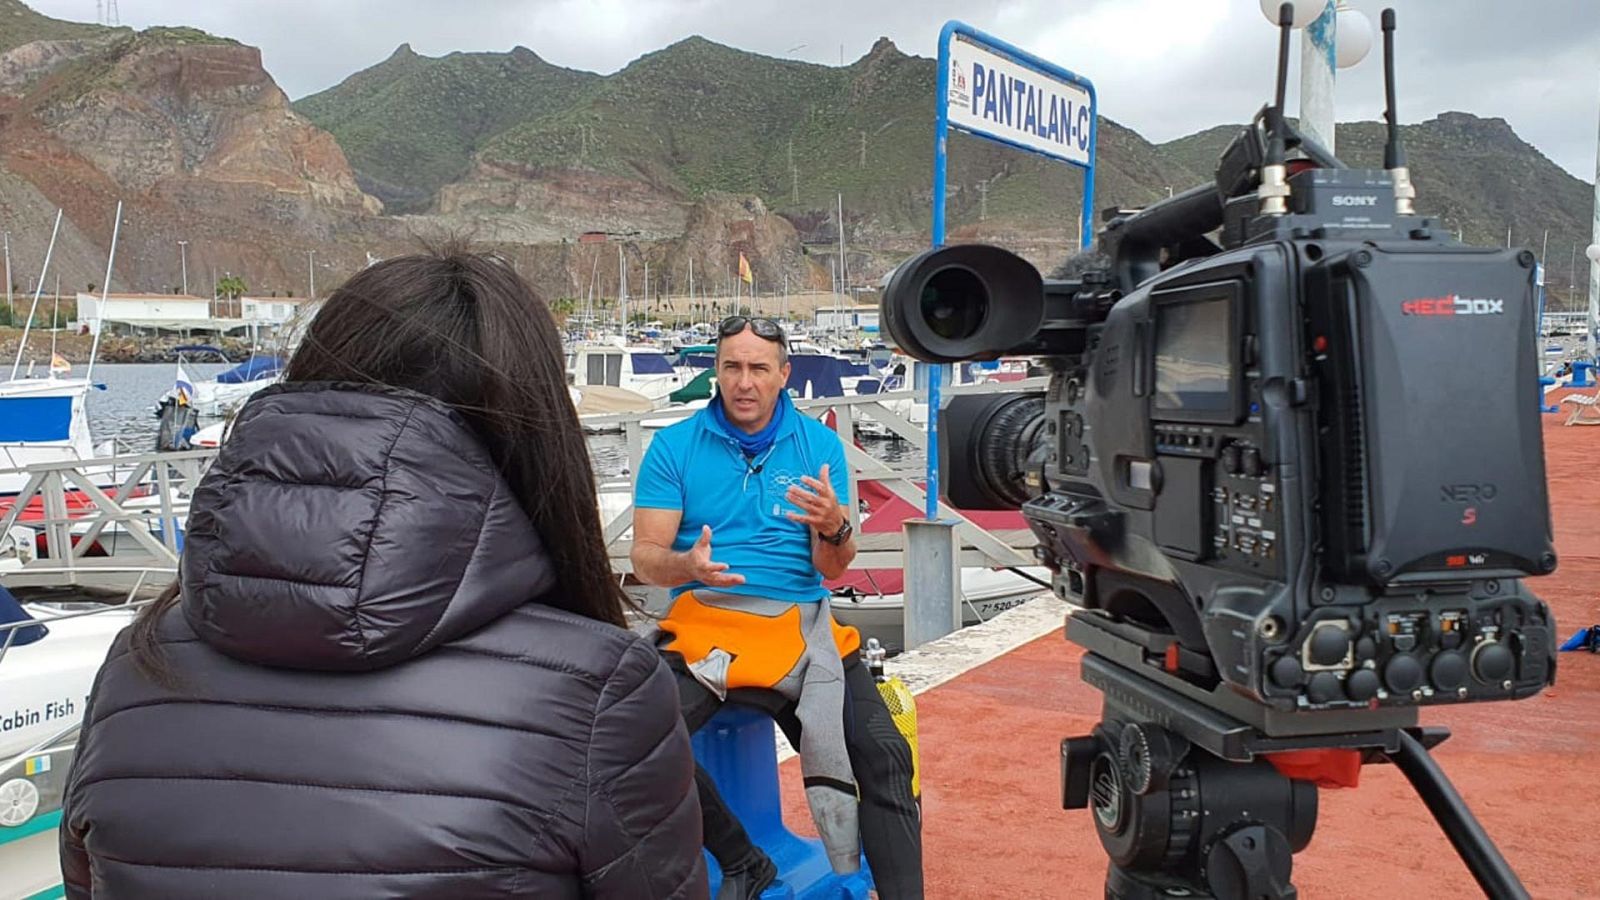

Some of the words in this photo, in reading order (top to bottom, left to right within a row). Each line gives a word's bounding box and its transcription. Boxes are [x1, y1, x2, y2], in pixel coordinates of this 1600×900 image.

[972, 62, 1088, 151] PANTALAN-C
[1332, 195, 1377, 206] SONY
[1440, 484, 1497, 503] NERO
[1461, 507, 1476, 525] S
[0, 709, 40, 733] abin
[46, 697, 74, 721] Fish
